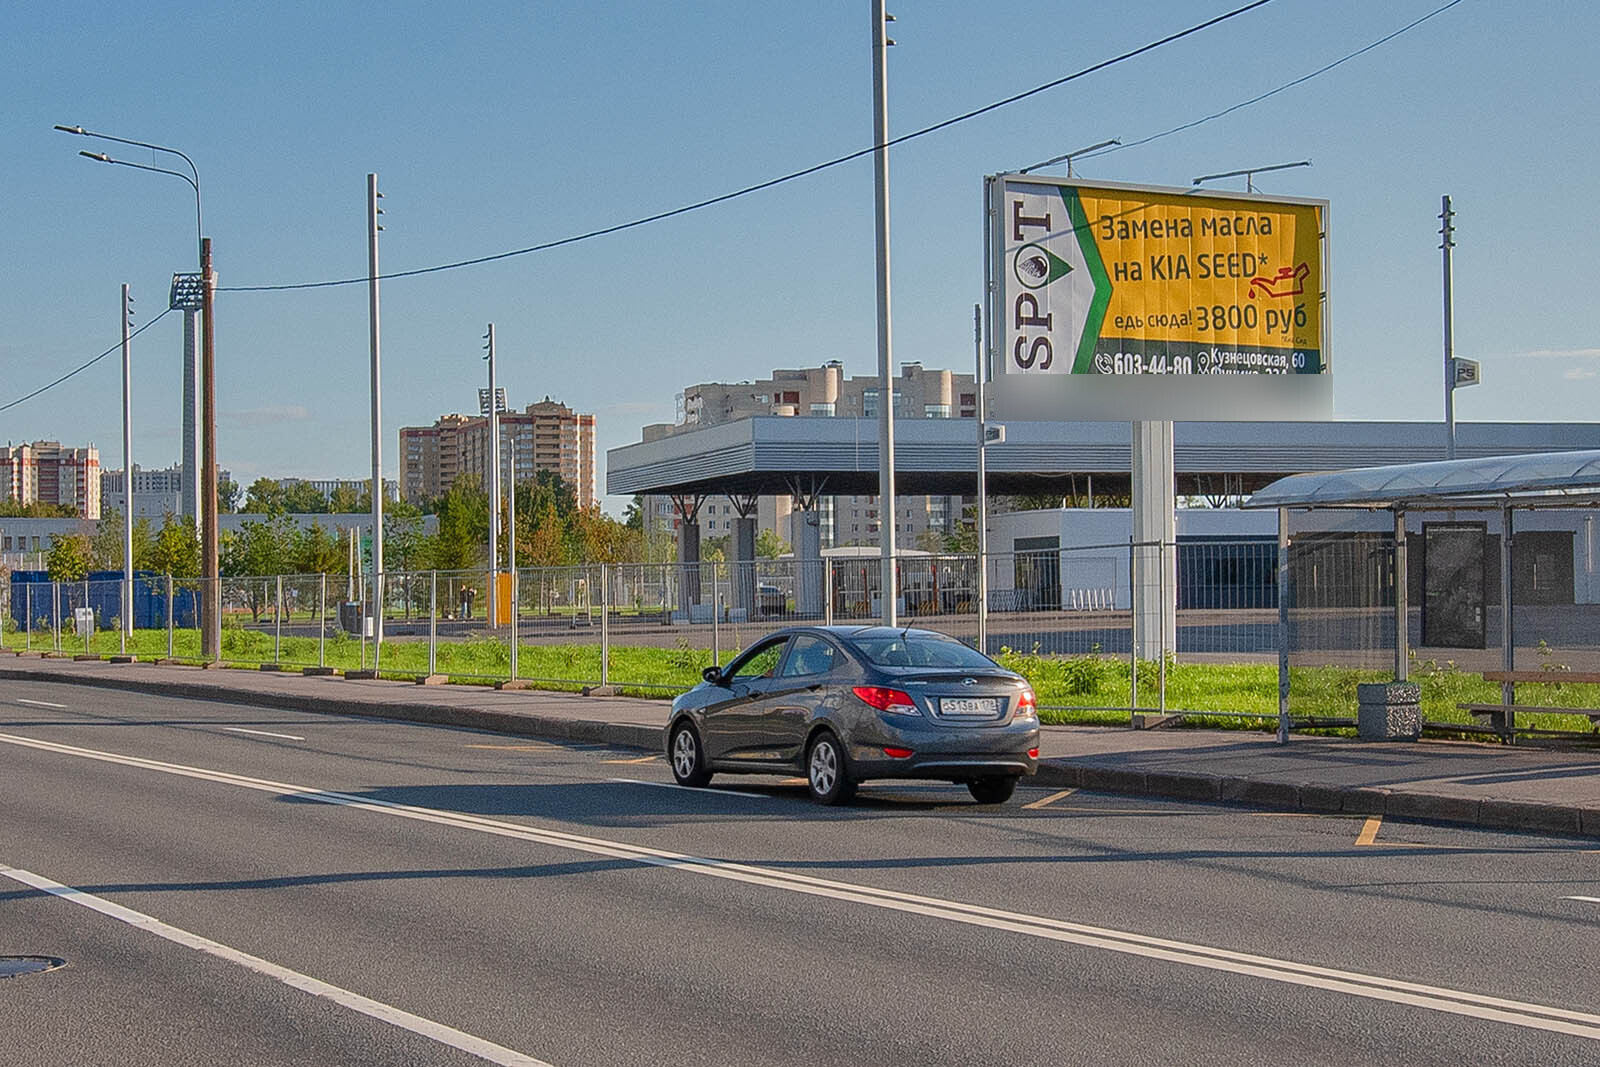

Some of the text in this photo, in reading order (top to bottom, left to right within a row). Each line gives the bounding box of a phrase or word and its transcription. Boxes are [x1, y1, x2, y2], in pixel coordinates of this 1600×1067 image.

[1101, 215, 1273, 240] Замена масла
[1114, 261, 1142, 282] на
[1150, 254, 1191, 281] KIA
[1013, 200, 1053, 370] SPOT
[1114, 310, 1193, 331] едь сюда!
[1196, 303, 1307, 334] 3800 руб
[1113, 353, 1193, 375] 603-44-80
[1210, 347, 1305, 369] Кузнецовская, 60
